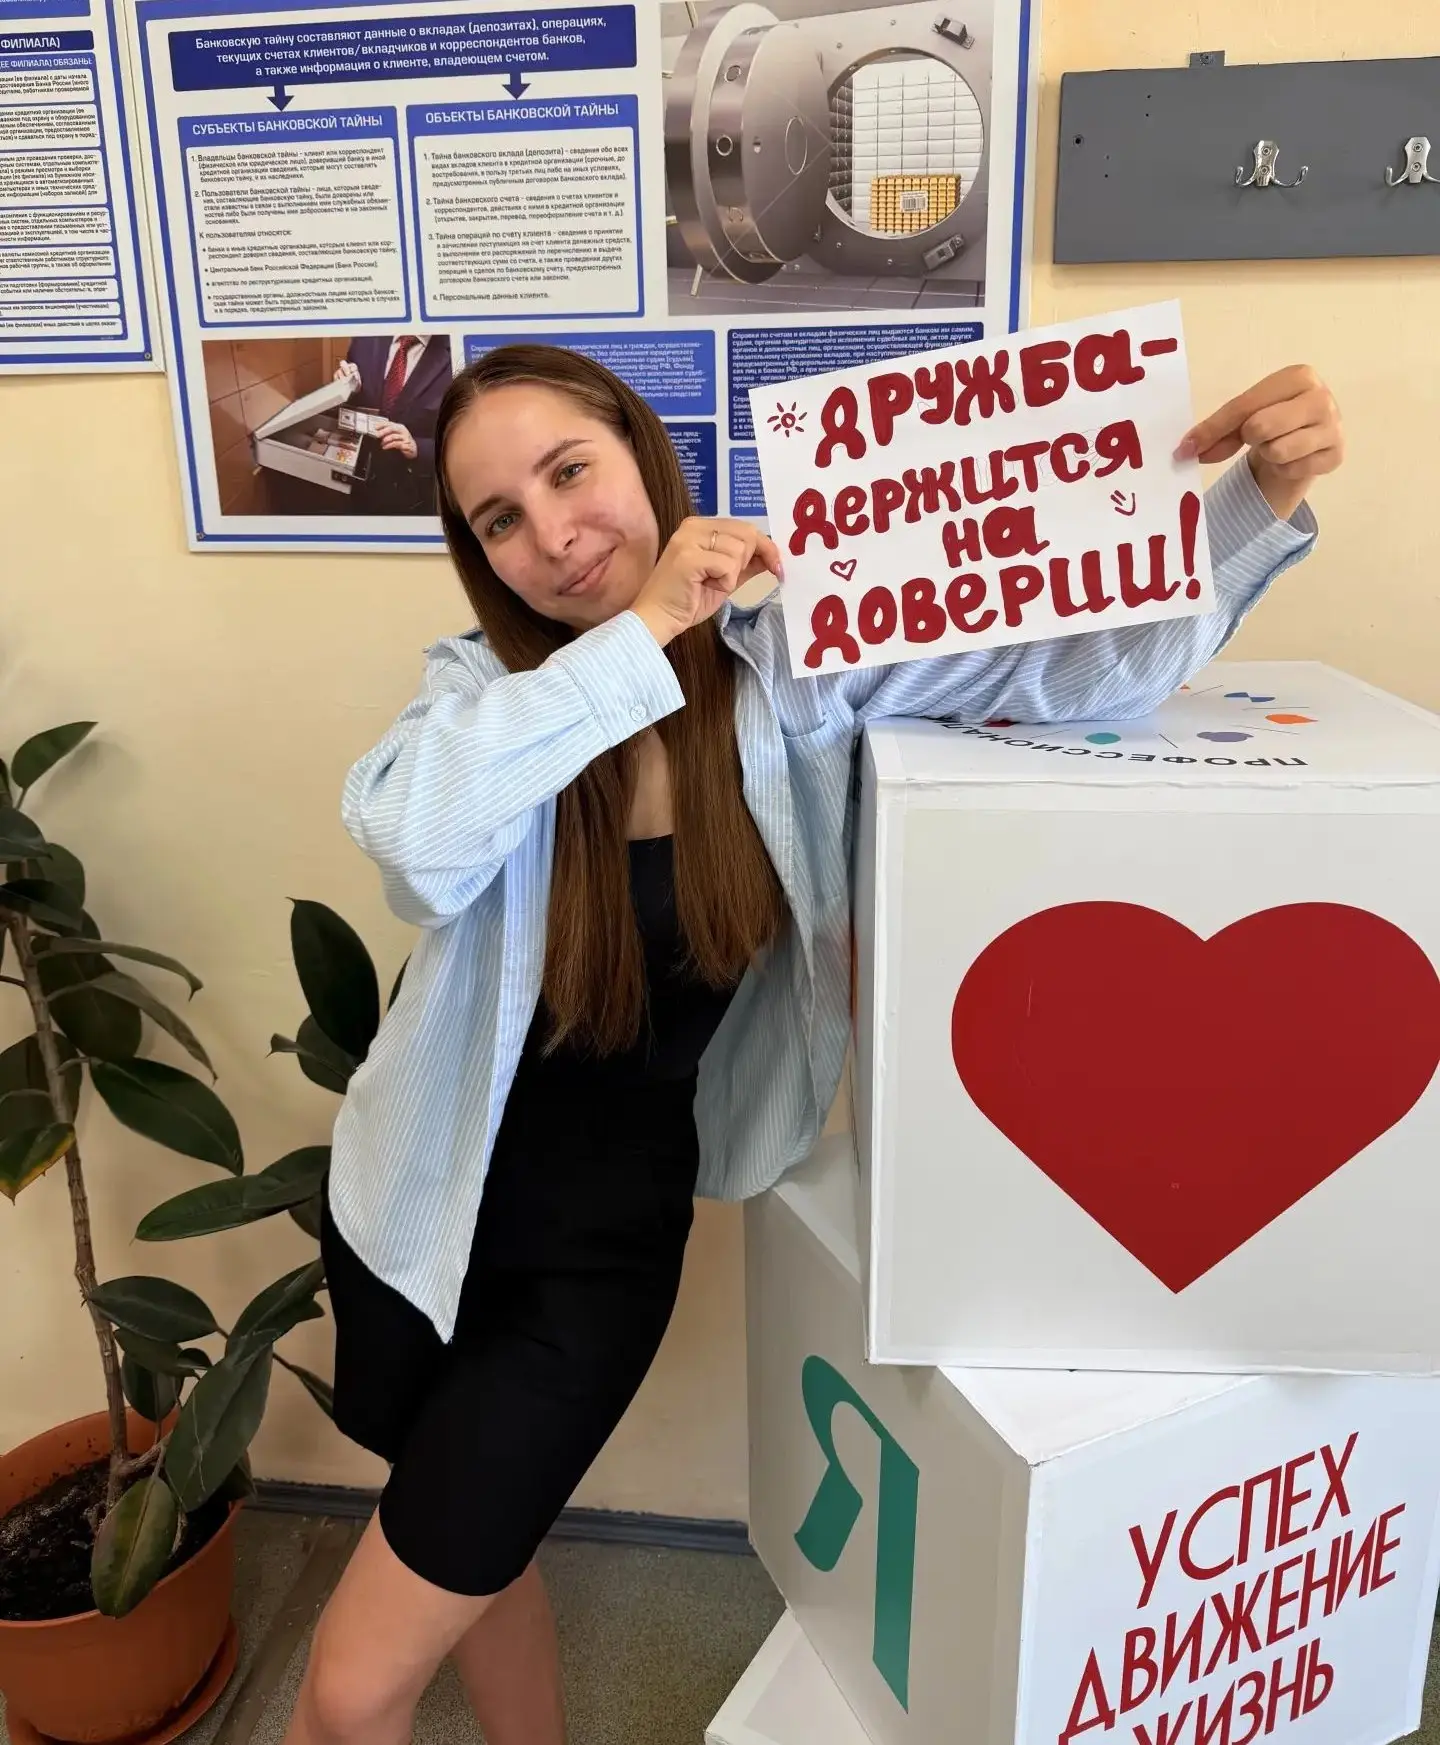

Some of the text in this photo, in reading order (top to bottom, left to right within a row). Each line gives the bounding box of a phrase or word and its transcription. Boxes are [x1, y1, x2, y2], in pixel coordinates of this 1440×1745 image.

[0, 36, 60, 49] ФИЛИАЛА)
[195, 17, 606, 51] Банковскую тайну составляют данные о вкладах (депозитах), операциях,
[216, 31, 586, 65] текущих счетах клиентов/вкладчиков и корреспондентов банков,
[255, 51, 549, 76] а также информация о клиенте, владеющем счетом.
[192, 112, 382, 135] СУБЪЕКТЫ БАНКОВСКОЙ ТАЙНЫ
[425, 101, 618, 123] ОБЪЕКТЫ БАНКОВСКОЙ ТАЙНЫ
[794, 1355, 920, 1713] Я
[1128, 1432, 1359, 1608] УСПЕХ
[1058, 1502, 1406, 1745] ДВИЖЕНИЕ
